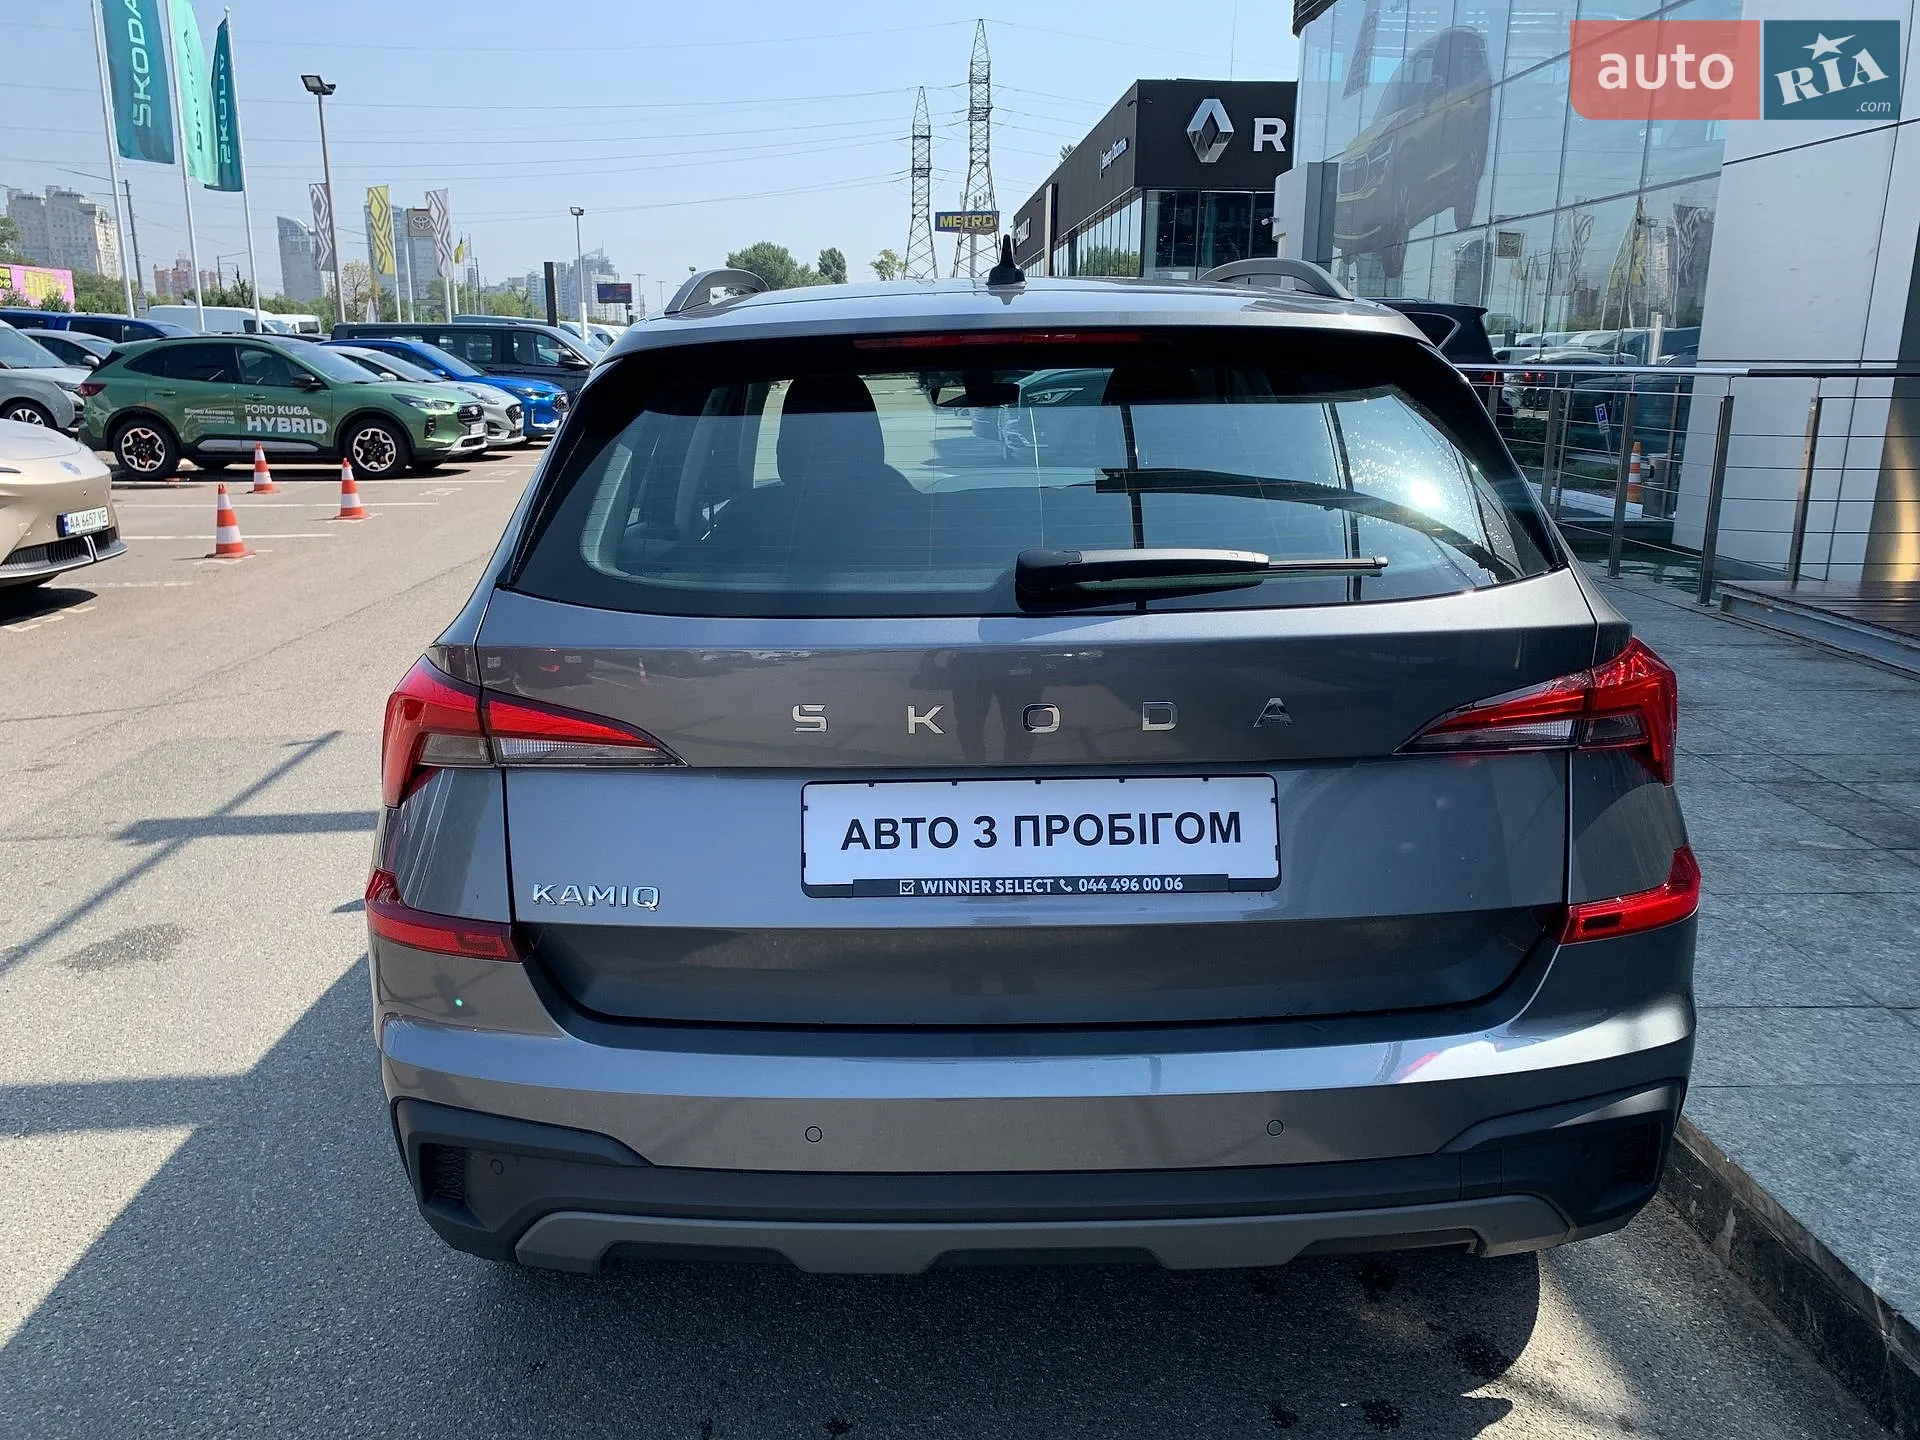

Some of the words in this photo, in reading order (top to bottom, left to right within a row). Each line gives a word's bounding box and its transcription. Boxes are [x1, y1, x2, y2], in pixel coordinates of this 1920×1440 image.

[939, 214, 996, 228] METRO
[245, 404, 275, 415] FORD
[277, 405, 311, 416] KUGA
[246, 416, 327, 434] HYBRID
[70, 515, 80, 529] AA
[82, 511, 97, 527] 6657
[792, 697, 1295, 735] SKODA
[841, 816, 959, 851] АВТО
[973, 815, 998, 850] З
[1014, 810, 1242, 848] ПРОБІГОМ
[921, 878, 992, 894] WINNER
[996, 877, 1054, 893] SELECT
[1078, 878, 1108, 892] 044
[1111, 878, 1139, 892] 496
[1143, 877, 1162, 892] 00
[1164, 877, 1184, 892] 06
[532, 883, 661, 911] KAMIQ
